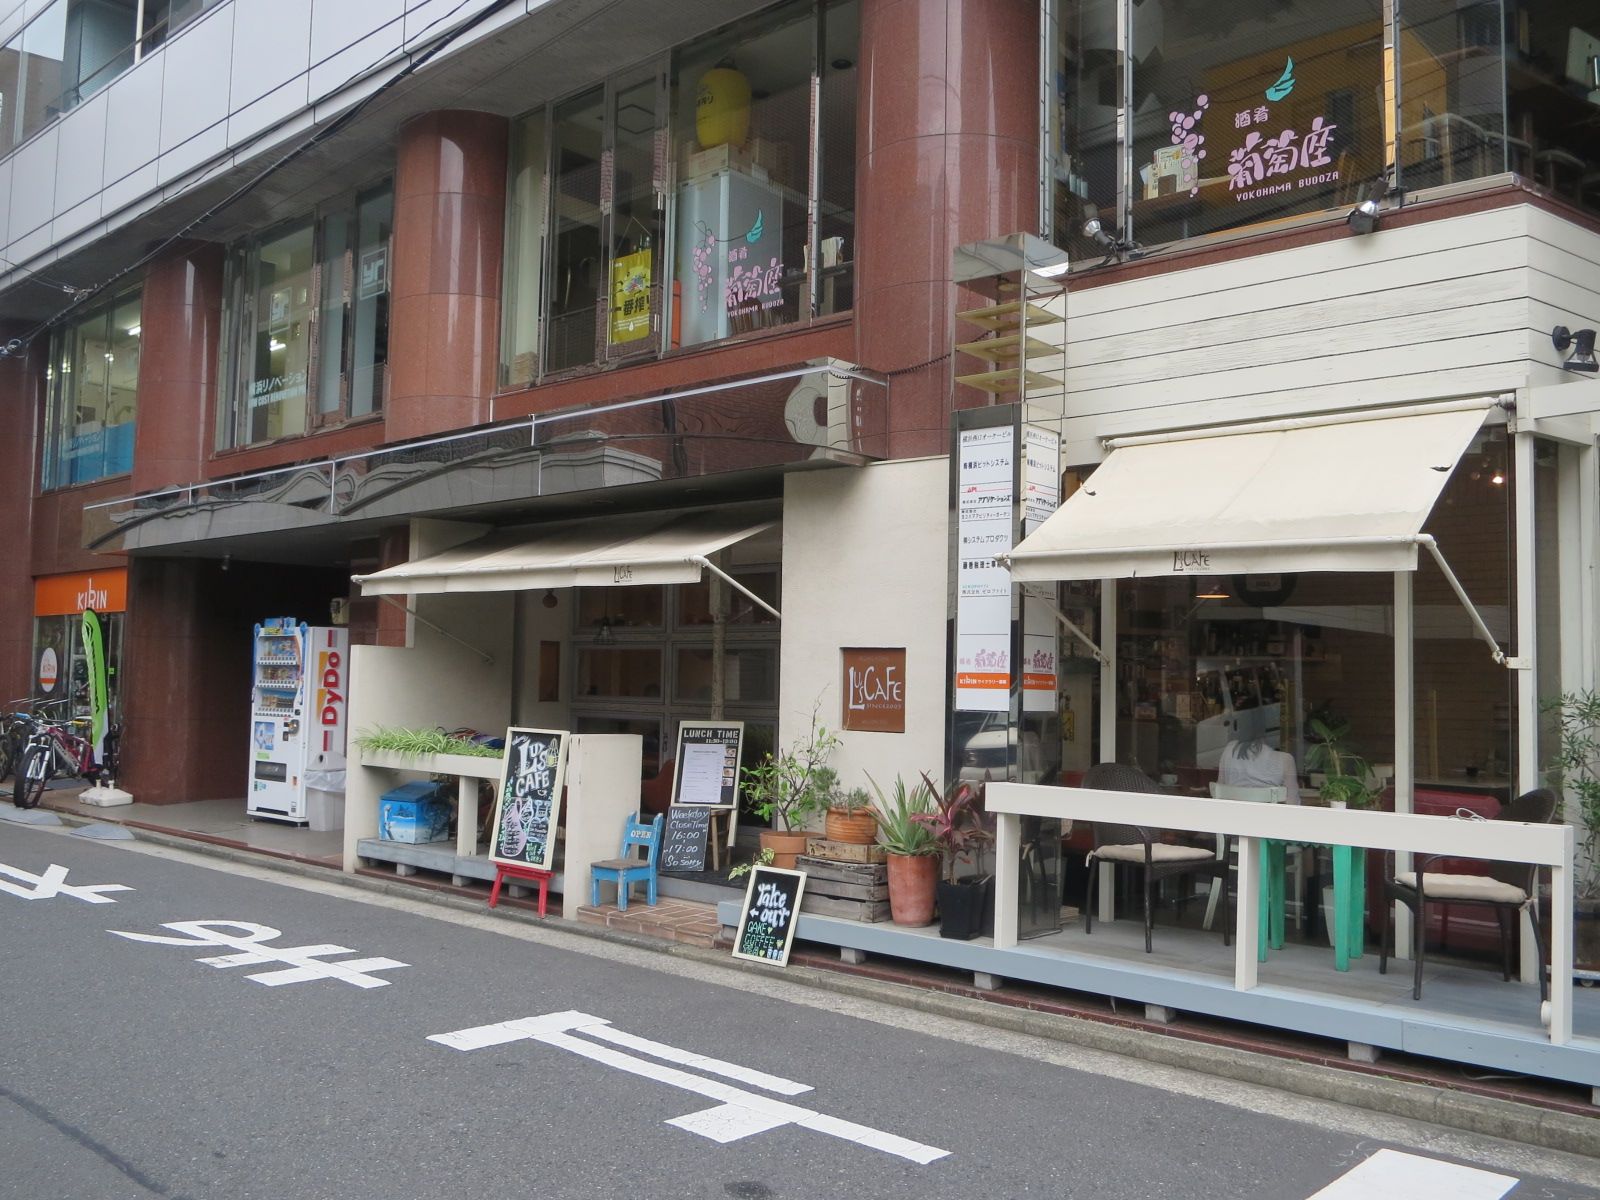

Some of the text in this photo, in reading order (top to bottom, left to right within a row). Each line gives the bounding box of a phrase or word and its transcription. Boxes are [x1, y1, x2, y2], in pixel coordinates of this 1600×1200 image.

[1234, 105, 1269, 129] 酒肴
[1227, 116, 1337, 191] 葡萄座
[1236, 171, 1339, 202] YOKOHAMA BUDOZA
[727, 305, 759, 318] YOKOHAMA
[77, 578, 107, 609] KIRIN
[321, 651, 343, 726] DyDo
[683, 729, 739, 739] LUNCH TIME
[516, 770, 550, 797] CAFE
[630, 830, 653, 839] OPEN
[671, 831, 700, 840] 16:00
